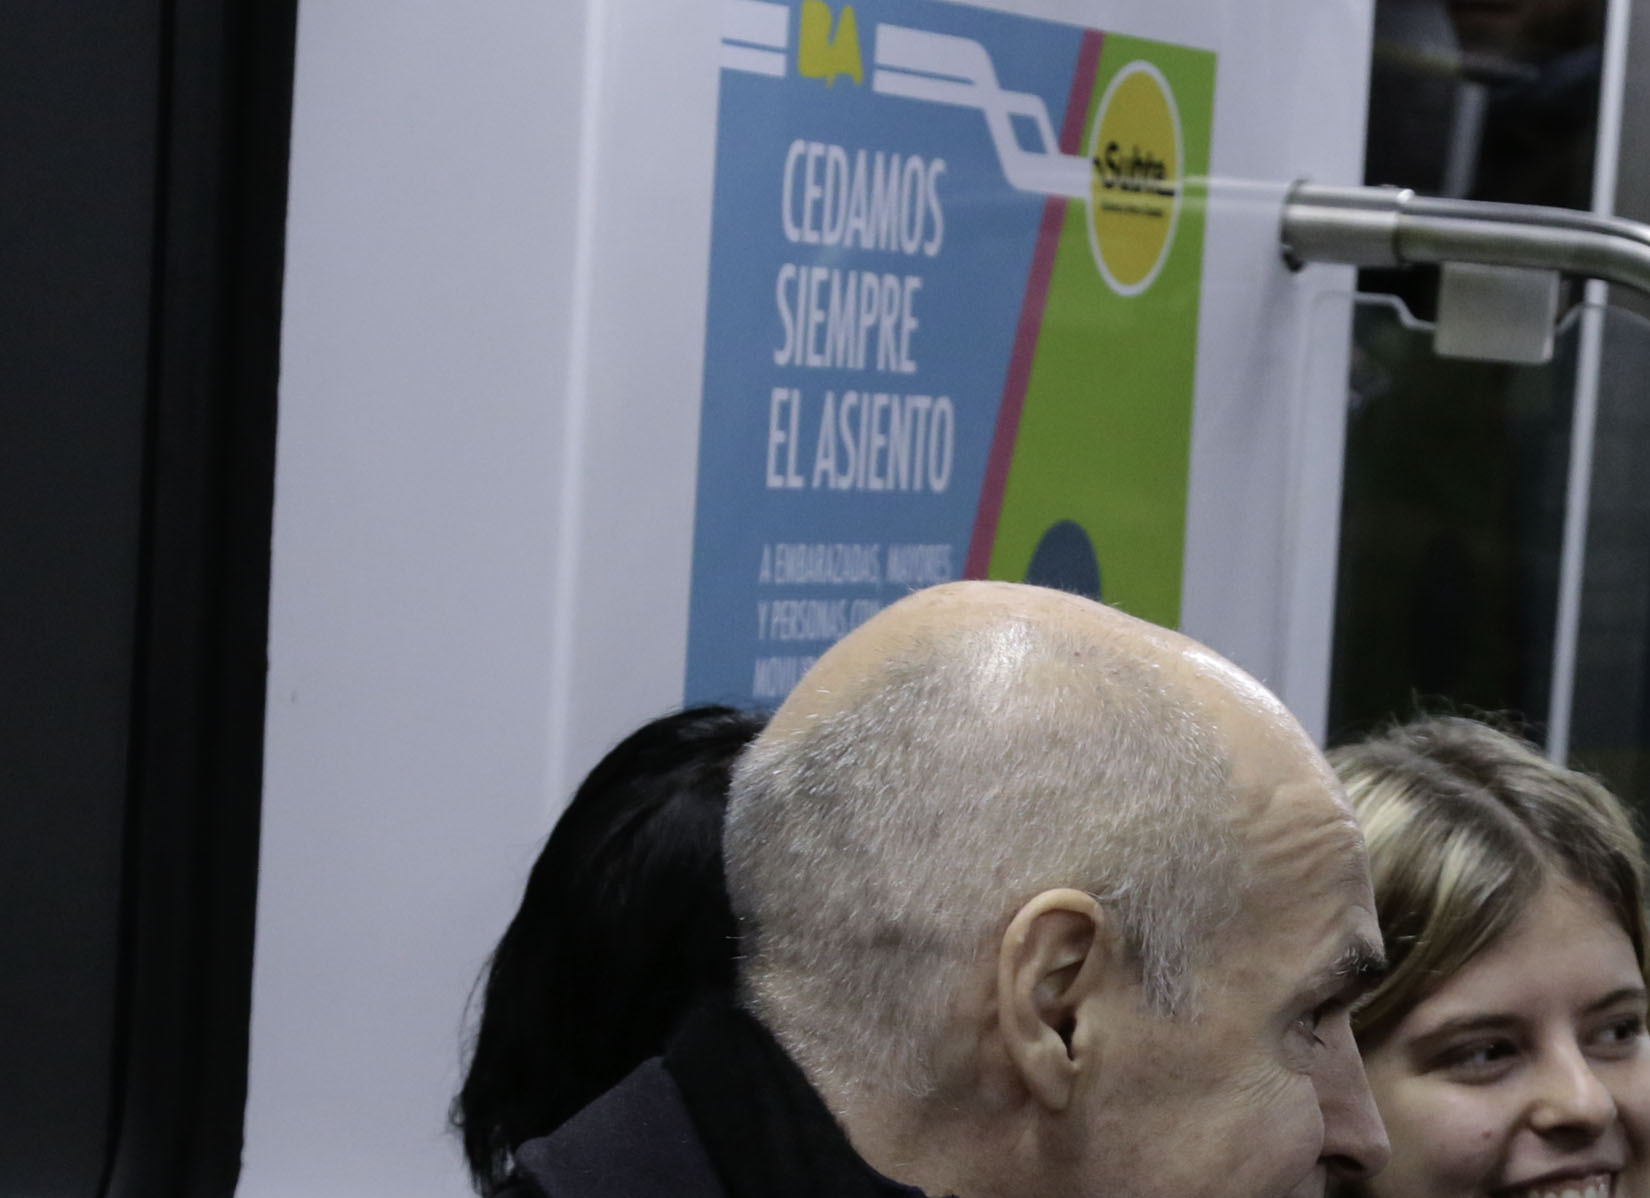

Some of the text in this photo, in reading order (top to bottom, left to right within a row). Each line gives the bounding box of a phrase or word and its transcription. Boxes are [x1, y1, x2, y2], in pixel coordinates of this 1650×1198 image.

[782, 138, 946, 256] CEDAMOS
[773, 262, 922, 374] SIEMPRE
[765, 387, 955, 493] EL ASIENTO
[759, 543, 771, 583] A
[757, 599, 770, 640] Y
